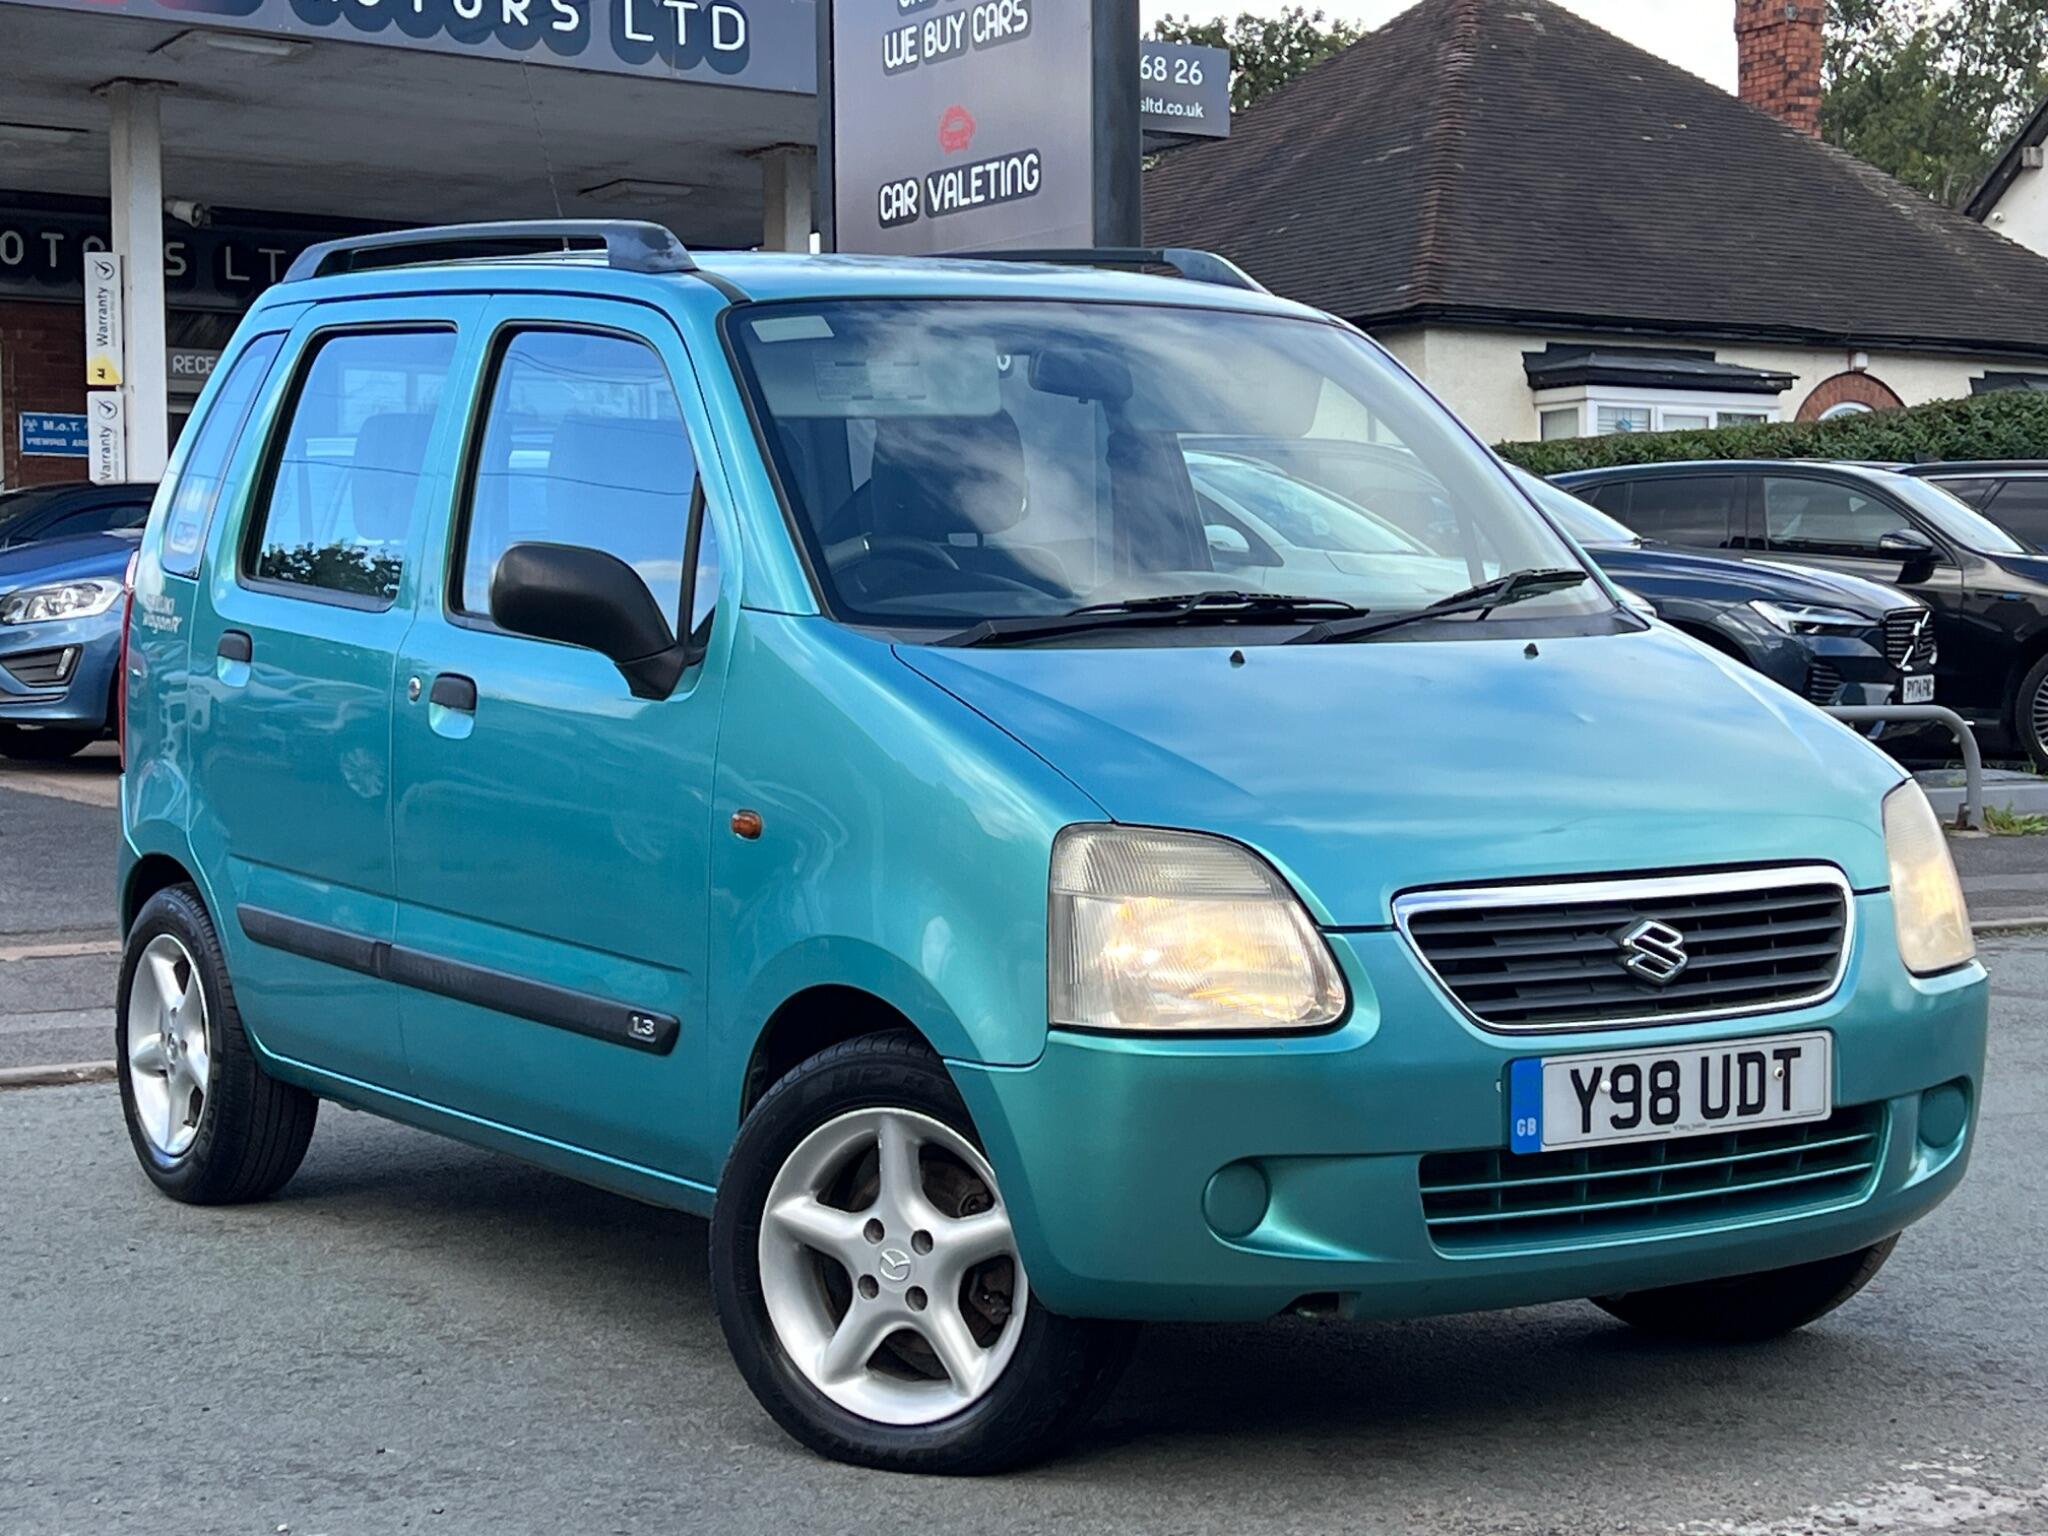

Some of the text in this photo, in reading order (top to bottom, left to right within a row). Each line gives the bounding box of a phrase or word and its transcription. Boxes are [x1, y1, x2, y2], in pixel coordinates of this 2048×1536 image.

[624, 0, 745, 51] LTD
[884, 0, 1029, 69] WE BUY CARS
[1175, 59, 1203, 86] 26
[880, 153, 1040, 221] CAR VALETING
[96, 287, 109, 347] Warranty
[1570, 1047, 1802, 1134] Y98 UDT
[1517, 1117, 1537, 1136] GB
